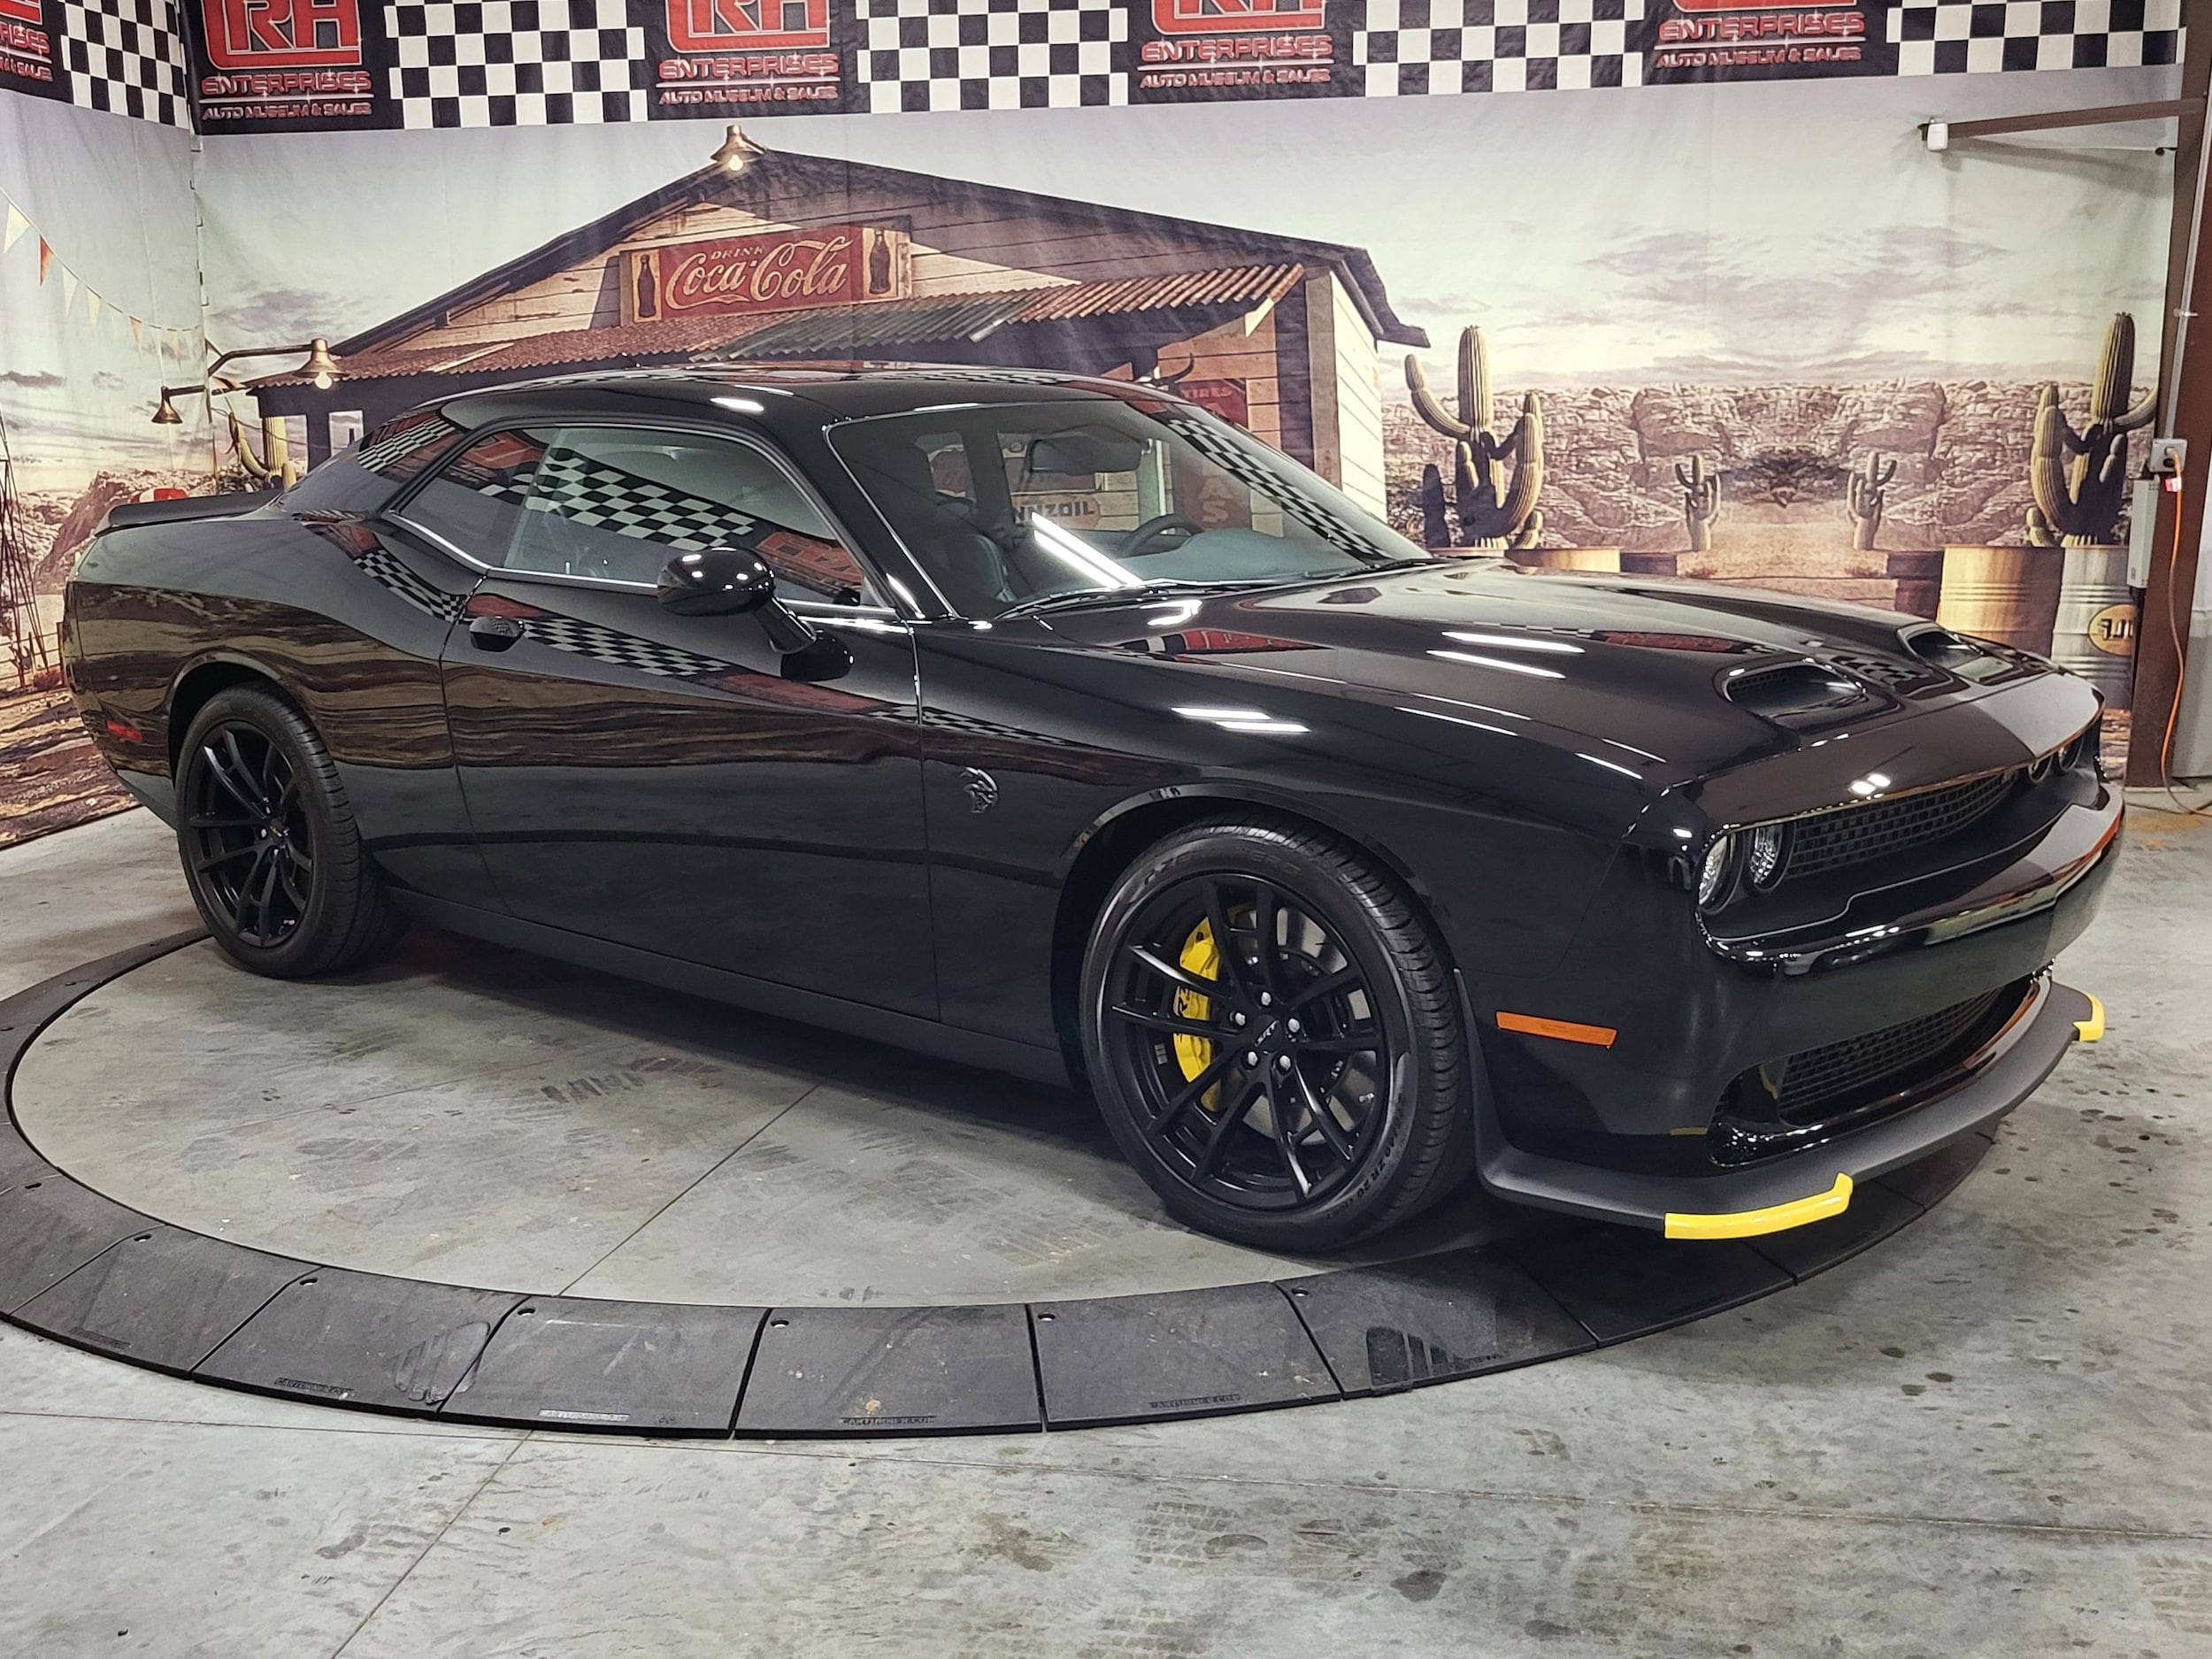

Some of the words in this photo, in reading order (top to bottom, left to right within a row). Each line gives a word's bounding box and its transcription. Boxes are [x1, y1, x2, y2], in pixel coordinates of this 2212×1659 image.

[1658, 12, 1865, 41] ENTERPRISES
[1141, 35, 1333, 63] ENTERPRISES
[1656, 51, 1706, 68] AUTO
[1708, 49, 1786, 65] MUSEUM
[1787, 48, 1801, 64] &
[1803, 46, 1862, 62] SALES
[658, 53, 840, 80] ENTERPRISES
[201, 71, 372, 96] ENTERPRISES
[1140, 73, 1187, 88] AUTO
[1188, 71, 1261, 87] MUSEUM
[1262, 70, 1275, 84] &
[1276, 68, 1331, 84] SALES
[658, 90, 703, 105] AUTO
[704, 88, 772, 104] MUSEUM
[773, 88, 786, 102] &
[787, 86, 839, 100] SALES
[202, 106, 244, 120] AUTO
[245, 104, 310, 119] MUSEUM
[311, 104, 323, 117] &
[323, 103, 373, 116] SALES
[710, 245, 764, 260] DRINK
[1180, 386, 1233, 399] TIRES
[1011, 500, 1094, 524] NNZOIL
